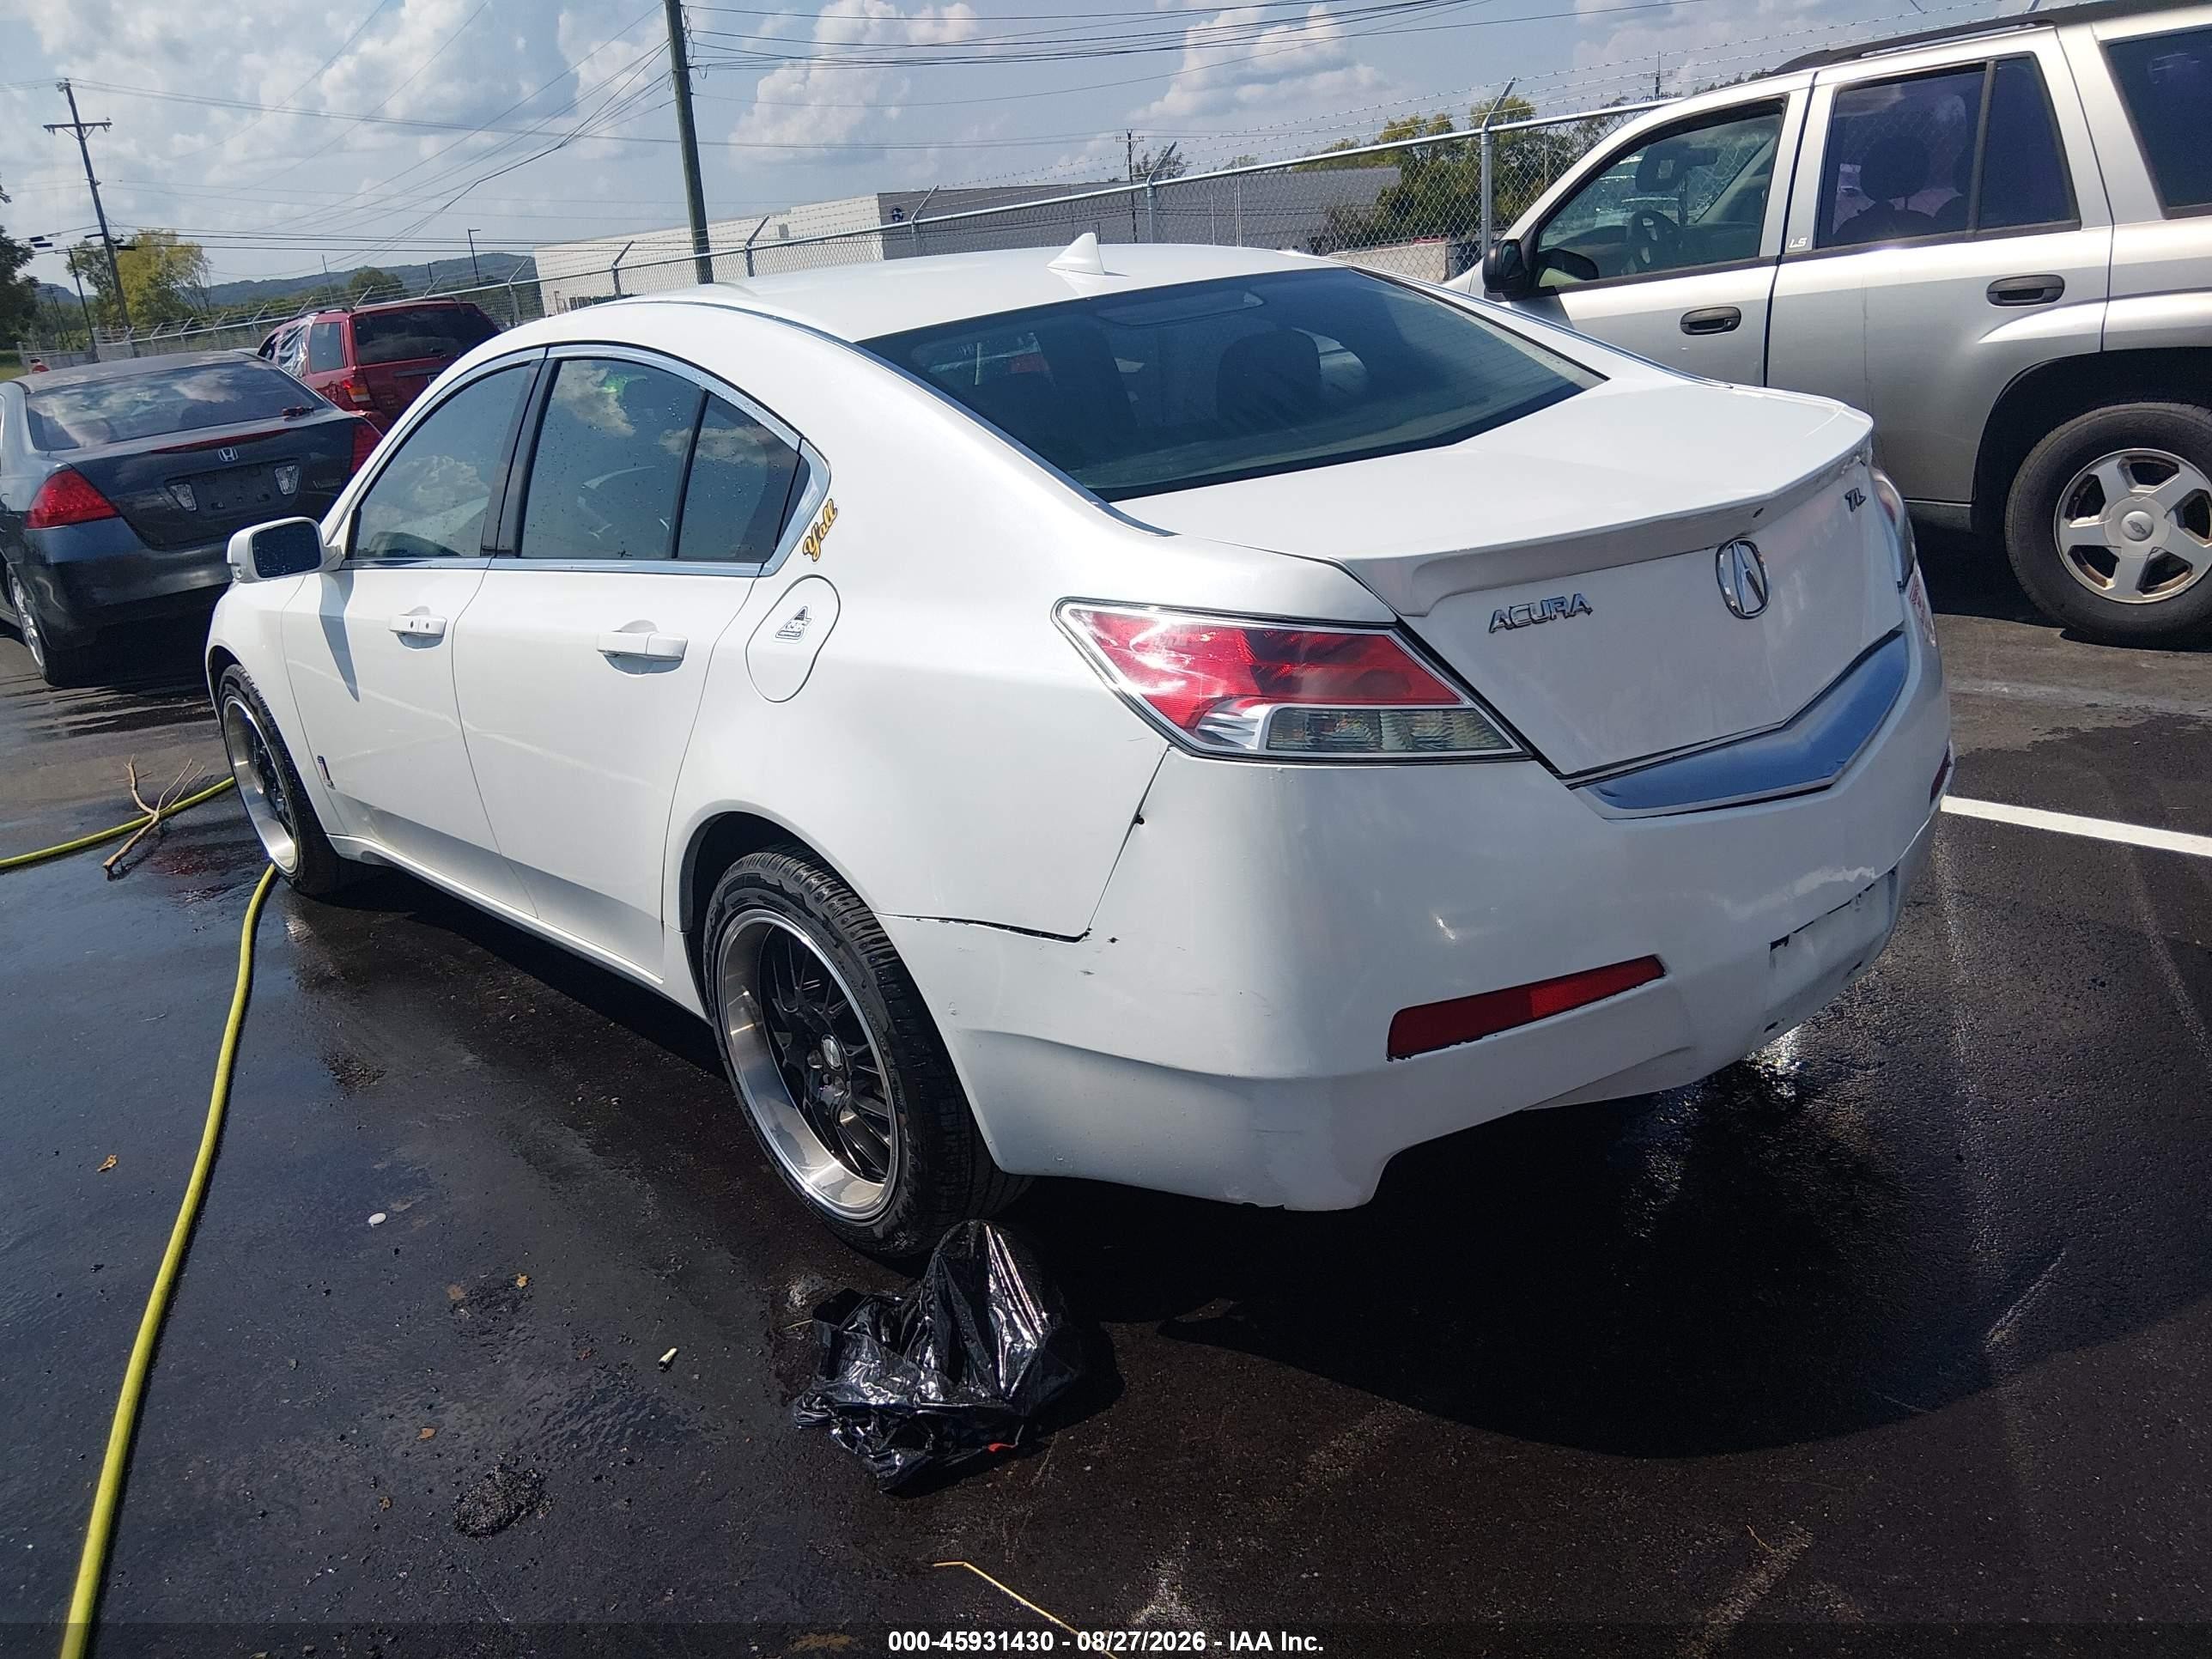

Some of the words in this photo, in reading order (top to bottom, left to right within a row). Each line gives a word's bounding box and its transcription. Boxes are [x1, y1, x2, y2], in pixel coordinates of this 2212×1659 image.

[1788, 237, 1808, 248] LS
[1844, 487, 1867, 513] TL
[1488, 592, 1594, 634] ACURA
